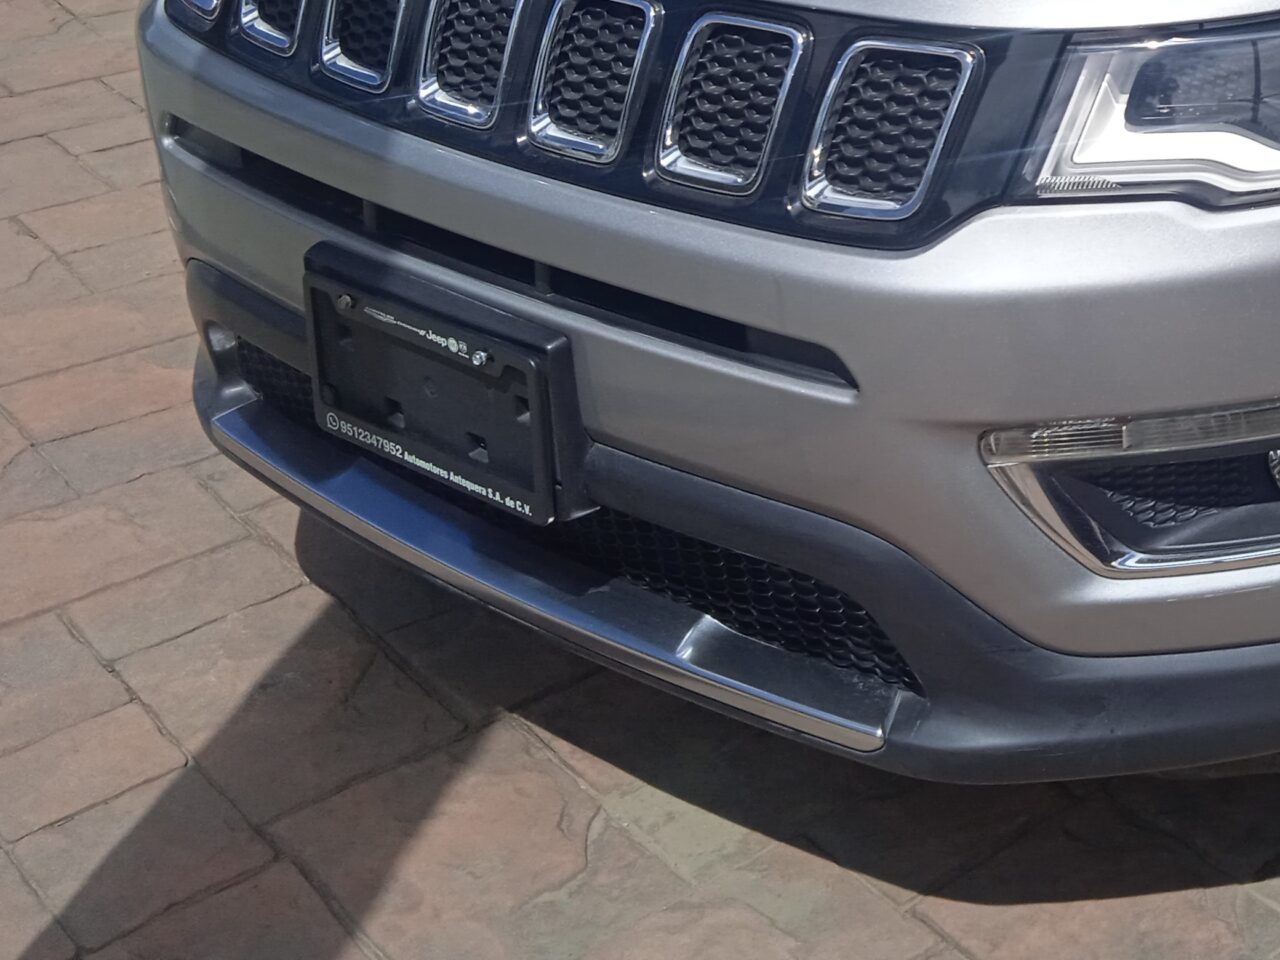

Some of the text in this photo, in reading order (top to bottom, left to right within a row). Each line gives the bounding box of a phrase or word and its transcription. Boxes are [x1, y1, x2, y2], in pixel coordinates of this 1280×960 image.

[426, 330, 448, 348] Jeep
[340, 420, 403, 458] 9512347952
[403, 451, 449, 480] Automotores
[449, 471, 487, 497] Antequera
[505, 496, 515, 509] de
[515, 501, 533, 516] C.V.
